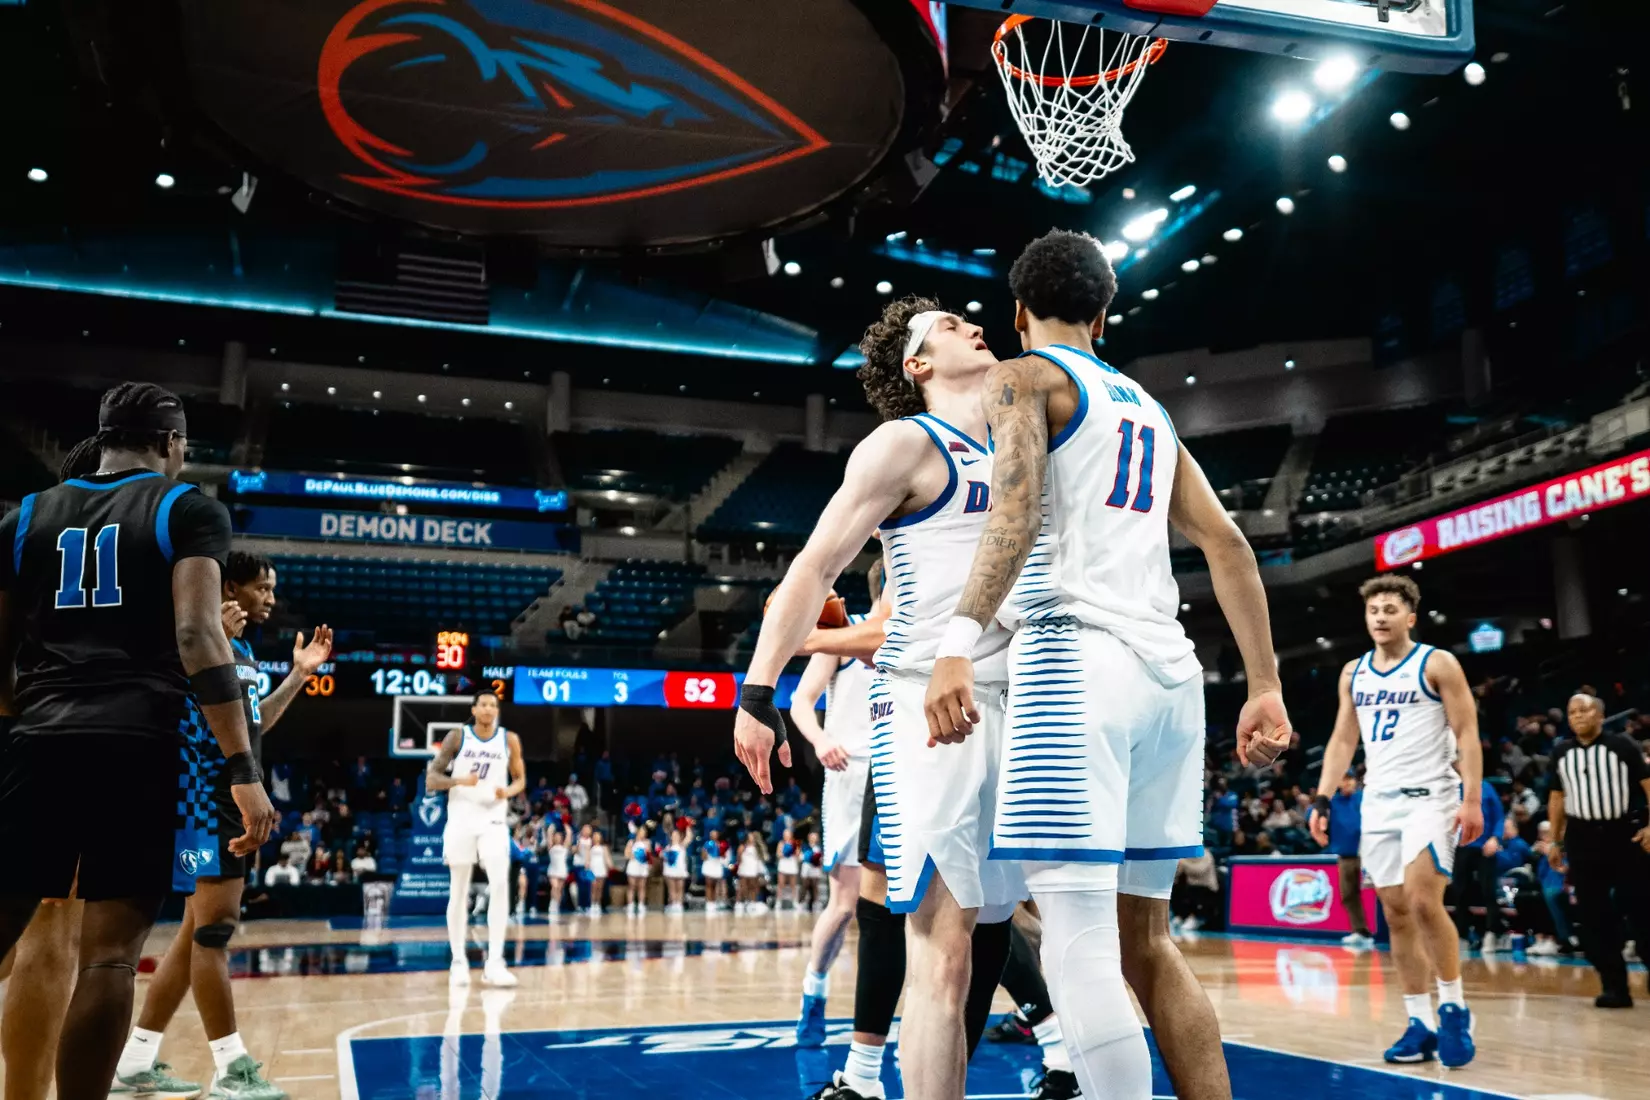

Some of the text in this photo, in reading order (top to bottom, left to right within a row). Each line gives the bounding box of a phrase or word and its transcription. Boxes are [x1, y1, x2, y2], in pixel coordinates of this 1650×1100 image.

[1105, 417, 1156, 513] 11
[1436, 491, 1543, 550] RAISING
[1545, 456, 1650, 518] CANE'S
[320, 512, 492, 545] DEMON DECK
[55, 523, 122, 609] 11
[256, 661, 290, 673] OULS
[436, 645, 466, 669] 30
[482, 666, 514, 678] HALF
[527, 669, 588, 680] TEAM FOULS
[304, 674, 335, 696] 30
[492, 679, 506, 700] 2
[542, 681, 570, 701] 01
[614, 682, 628, 703] 3
[684, 678, 716, 703] 52
[1371, 709, 1401, 742] 12
[470, 761, 491, 780] 20
